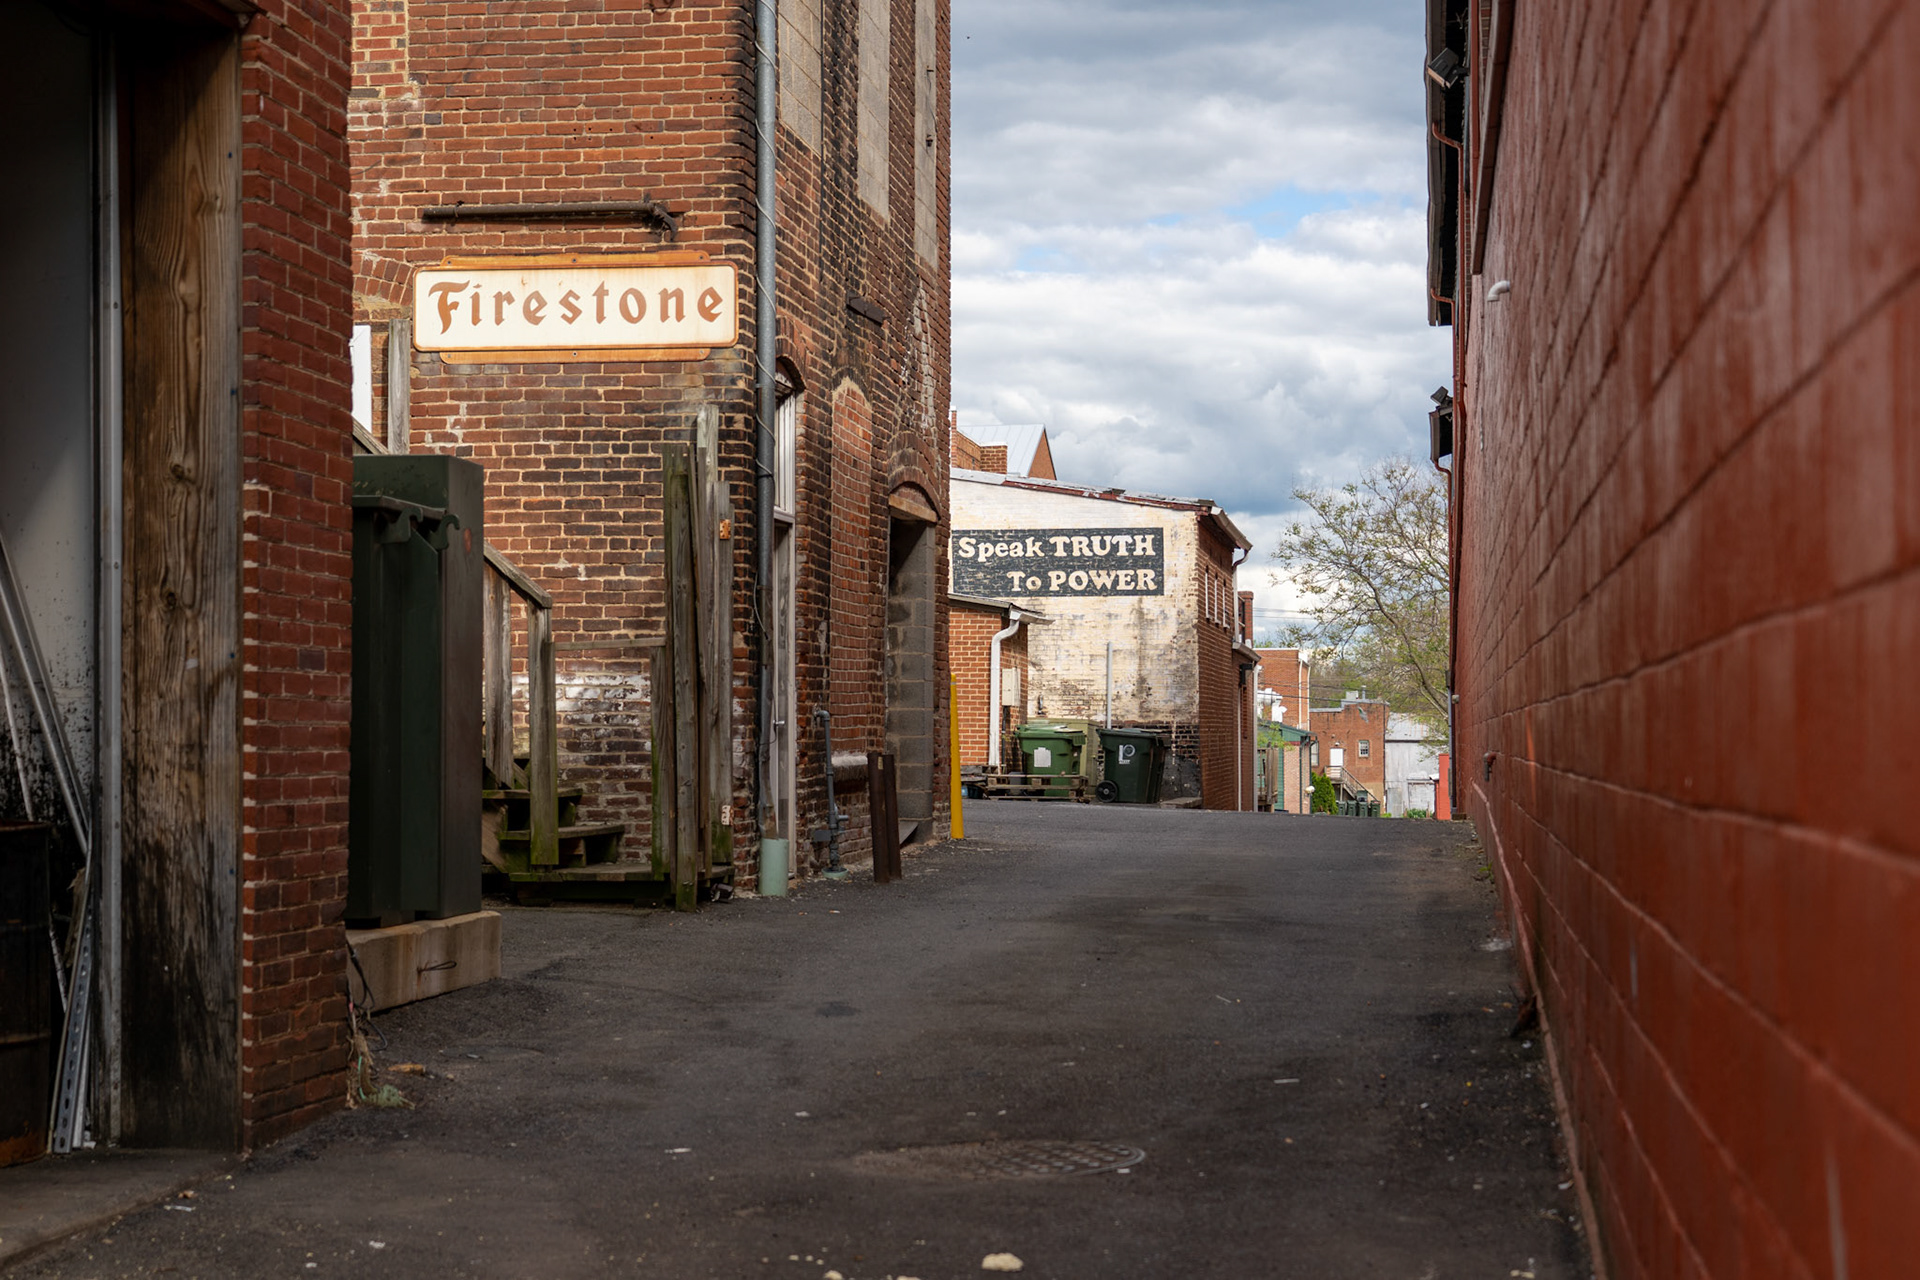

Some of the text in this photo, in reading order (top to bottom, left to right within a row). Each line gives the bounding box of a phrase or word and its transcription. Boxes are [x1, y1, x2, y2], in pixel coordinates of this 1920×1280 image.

[428, 280, 723, 335] Firestone
[958, 535, 1156, 562] Speak TRUTH
[1007, 569, 1157, 591] To POWER
